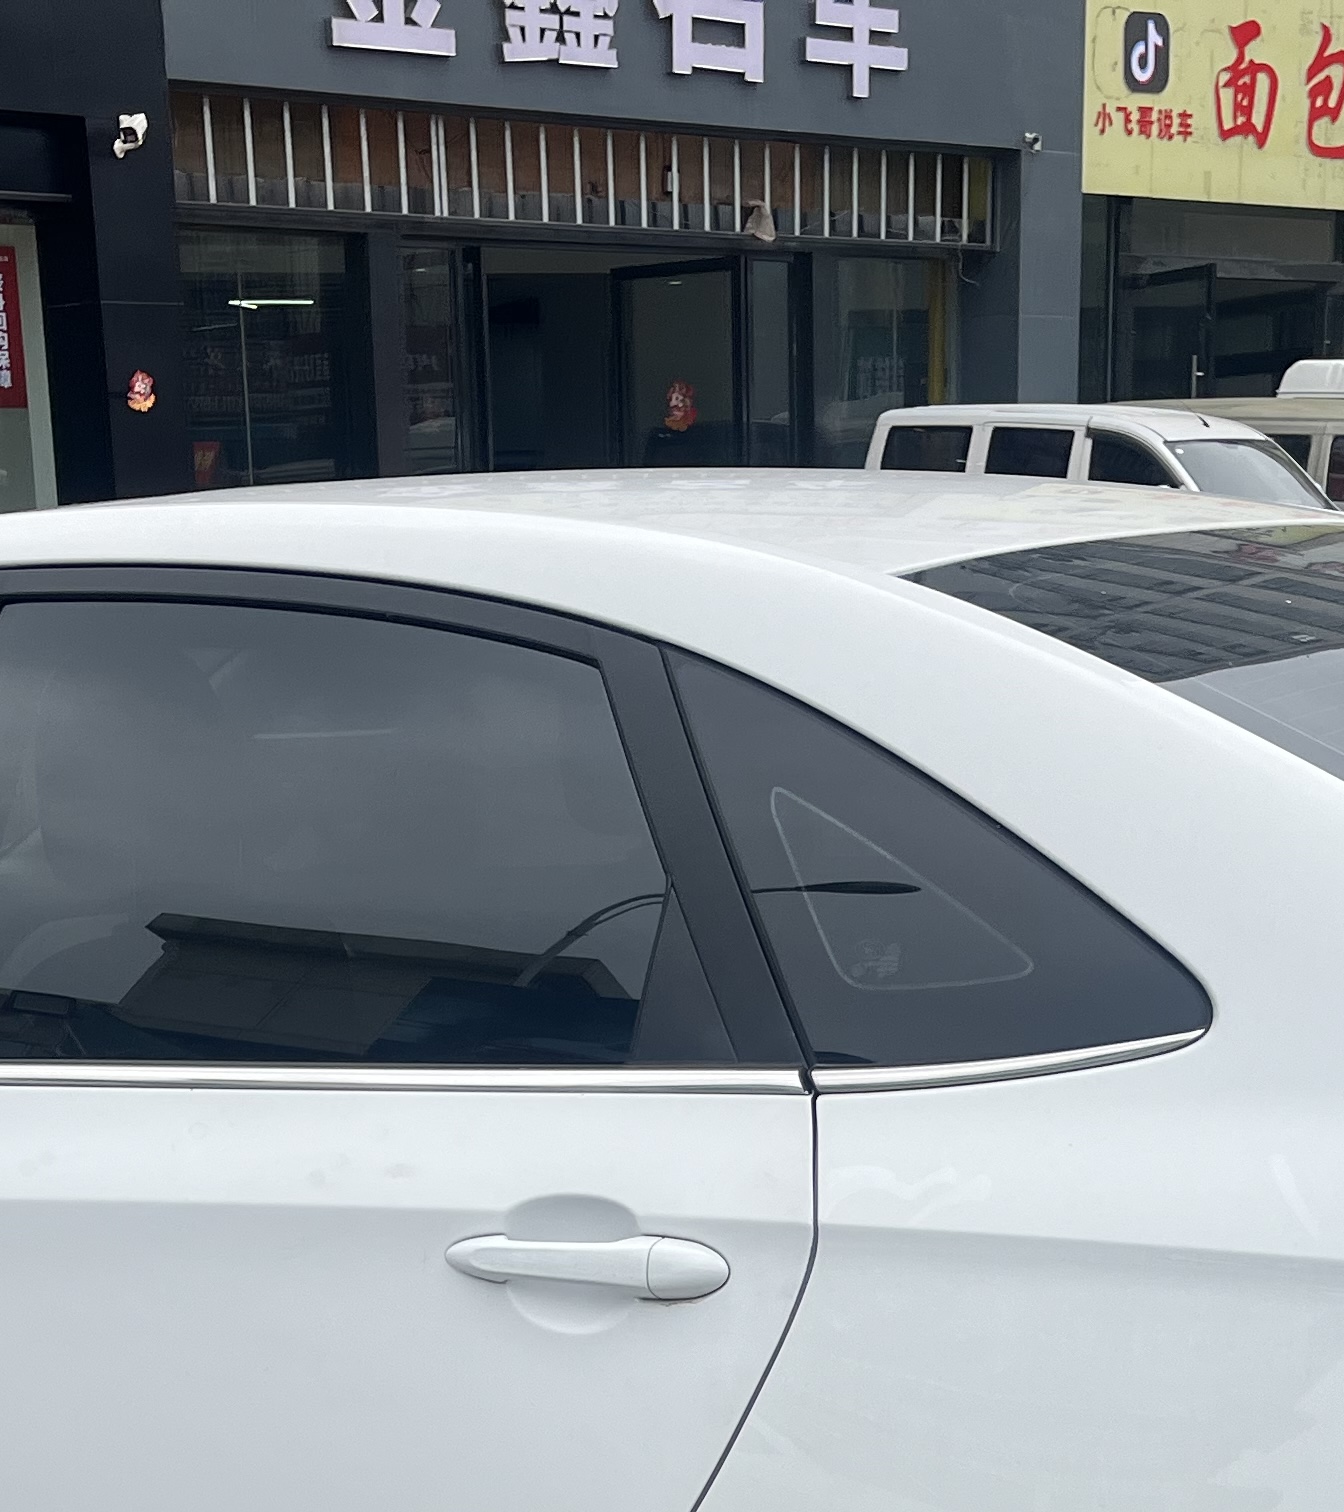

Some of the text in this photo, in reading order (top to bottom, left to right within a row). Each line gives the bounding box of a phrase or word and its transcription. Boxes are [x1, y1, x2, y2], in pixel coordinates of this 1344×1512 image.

[1094, 103, 1193, 142] 小飞哥说车
